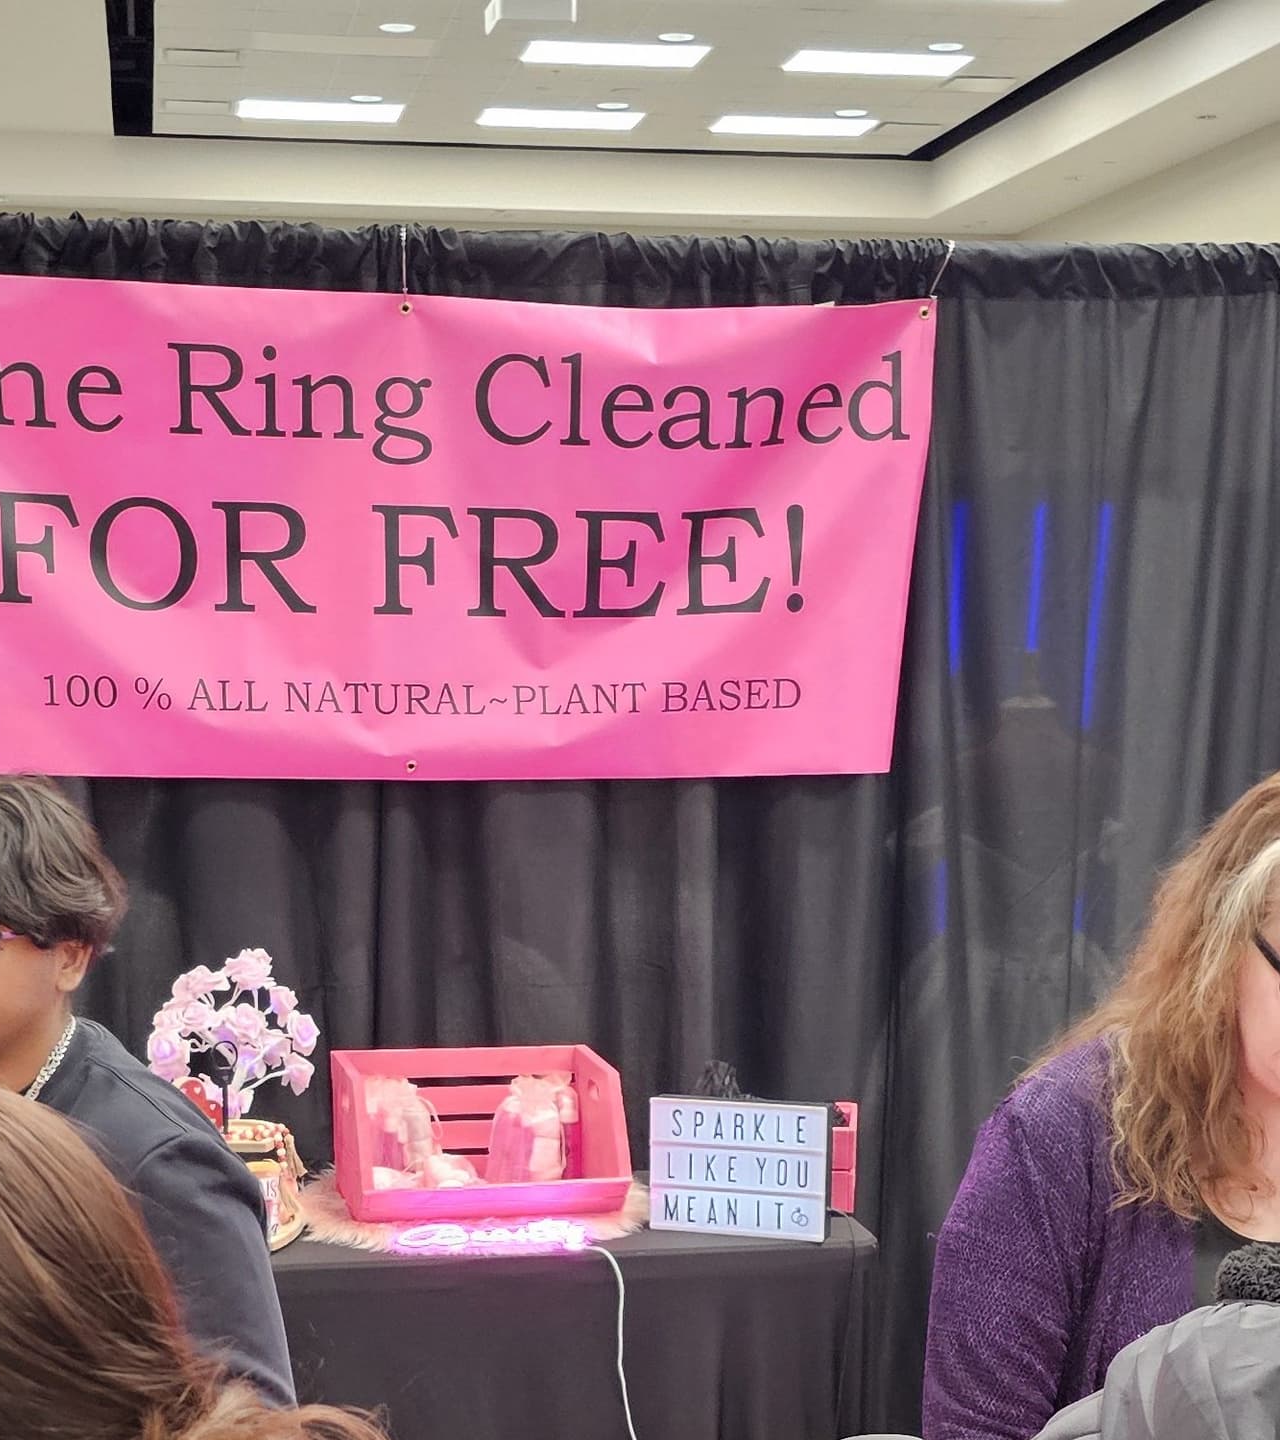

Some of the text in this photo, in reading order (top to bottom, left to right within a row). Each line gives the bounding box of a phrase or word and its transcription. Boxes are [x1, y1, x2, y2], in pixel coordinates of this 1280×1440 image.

[167, 342, 432, 465] Ring
[475, 350, 911, 450] Cleaned
[372, 504, 805, 619] FREE!
[42, 674, 118, 708] 100
[134, 677, 173, 711] %
[187, 678, 269, 712] ALL
[661, 678, 802, 713] BASED
[671, 1109, 807, 1143] SPARKLE
[667, 1152, 808, 1188] LIKE YOU
[664, 1194, 784, 1229] MEAN IT
